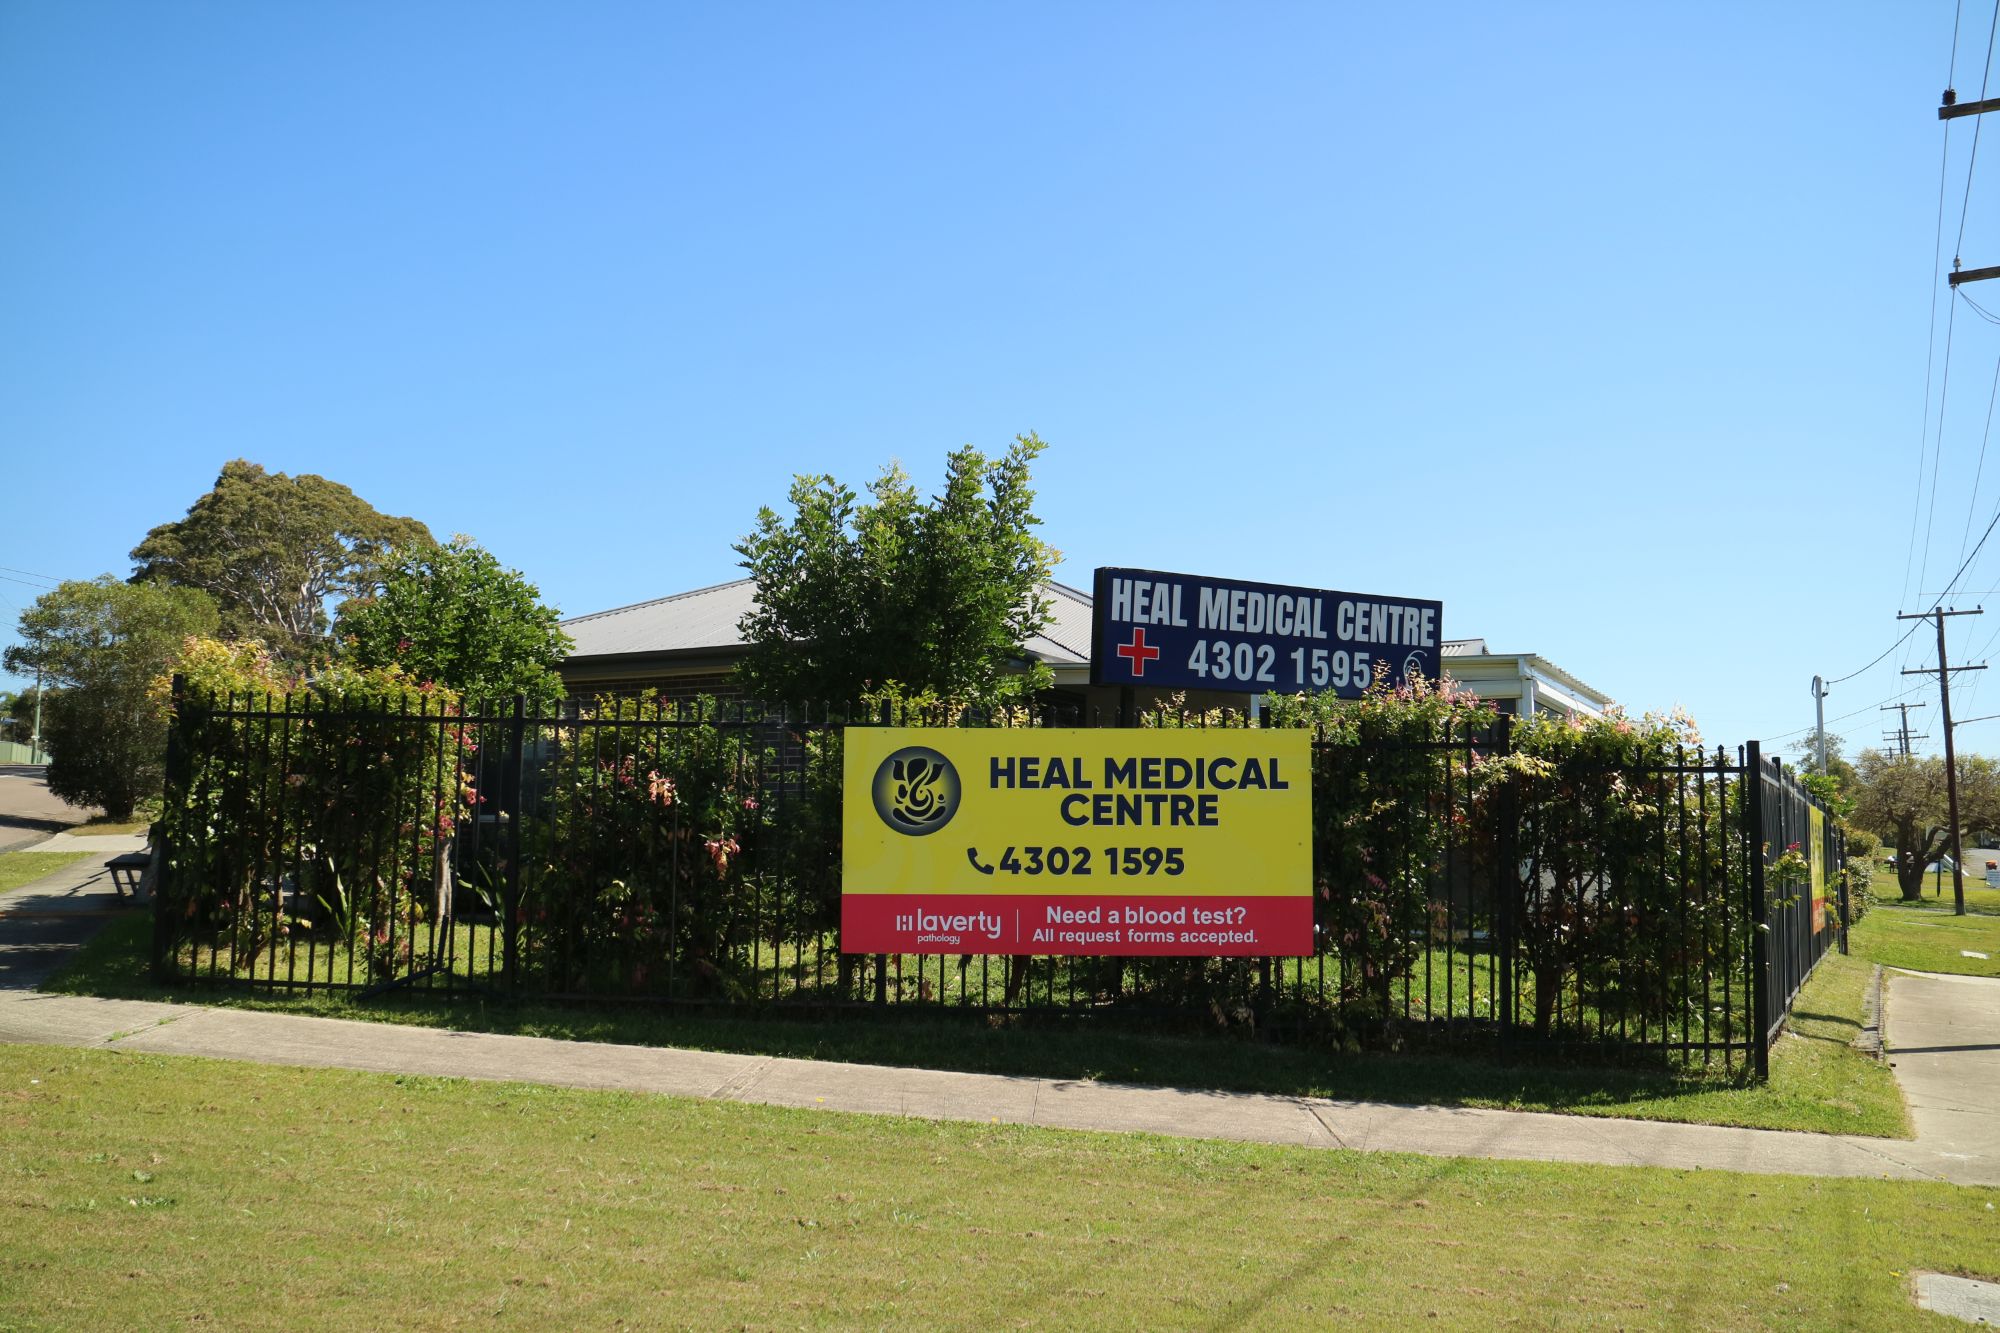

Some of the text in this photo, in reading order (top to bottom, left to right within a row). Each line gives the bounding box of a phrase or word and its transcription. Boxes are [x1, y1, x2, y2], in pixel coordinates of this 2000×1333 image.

[1111, 578, 1435, 647] HEAL MEDICAL CENTRE
[1188, 639, 1370, 689] 4302 1595
[990, 757, 1289, 790] HEAL MEDICAL
[1060, 793, 1219, 826] CENTRE
[1000, 846, 1185, 876] 4302 1595
[917, 908, 1001, 939] laverty
[1046, 906, 1247, 925] Need a blood test?
[917, 933, 960, 945] pathology
[1032, 928, 1258, 946] All request forms accepted.
